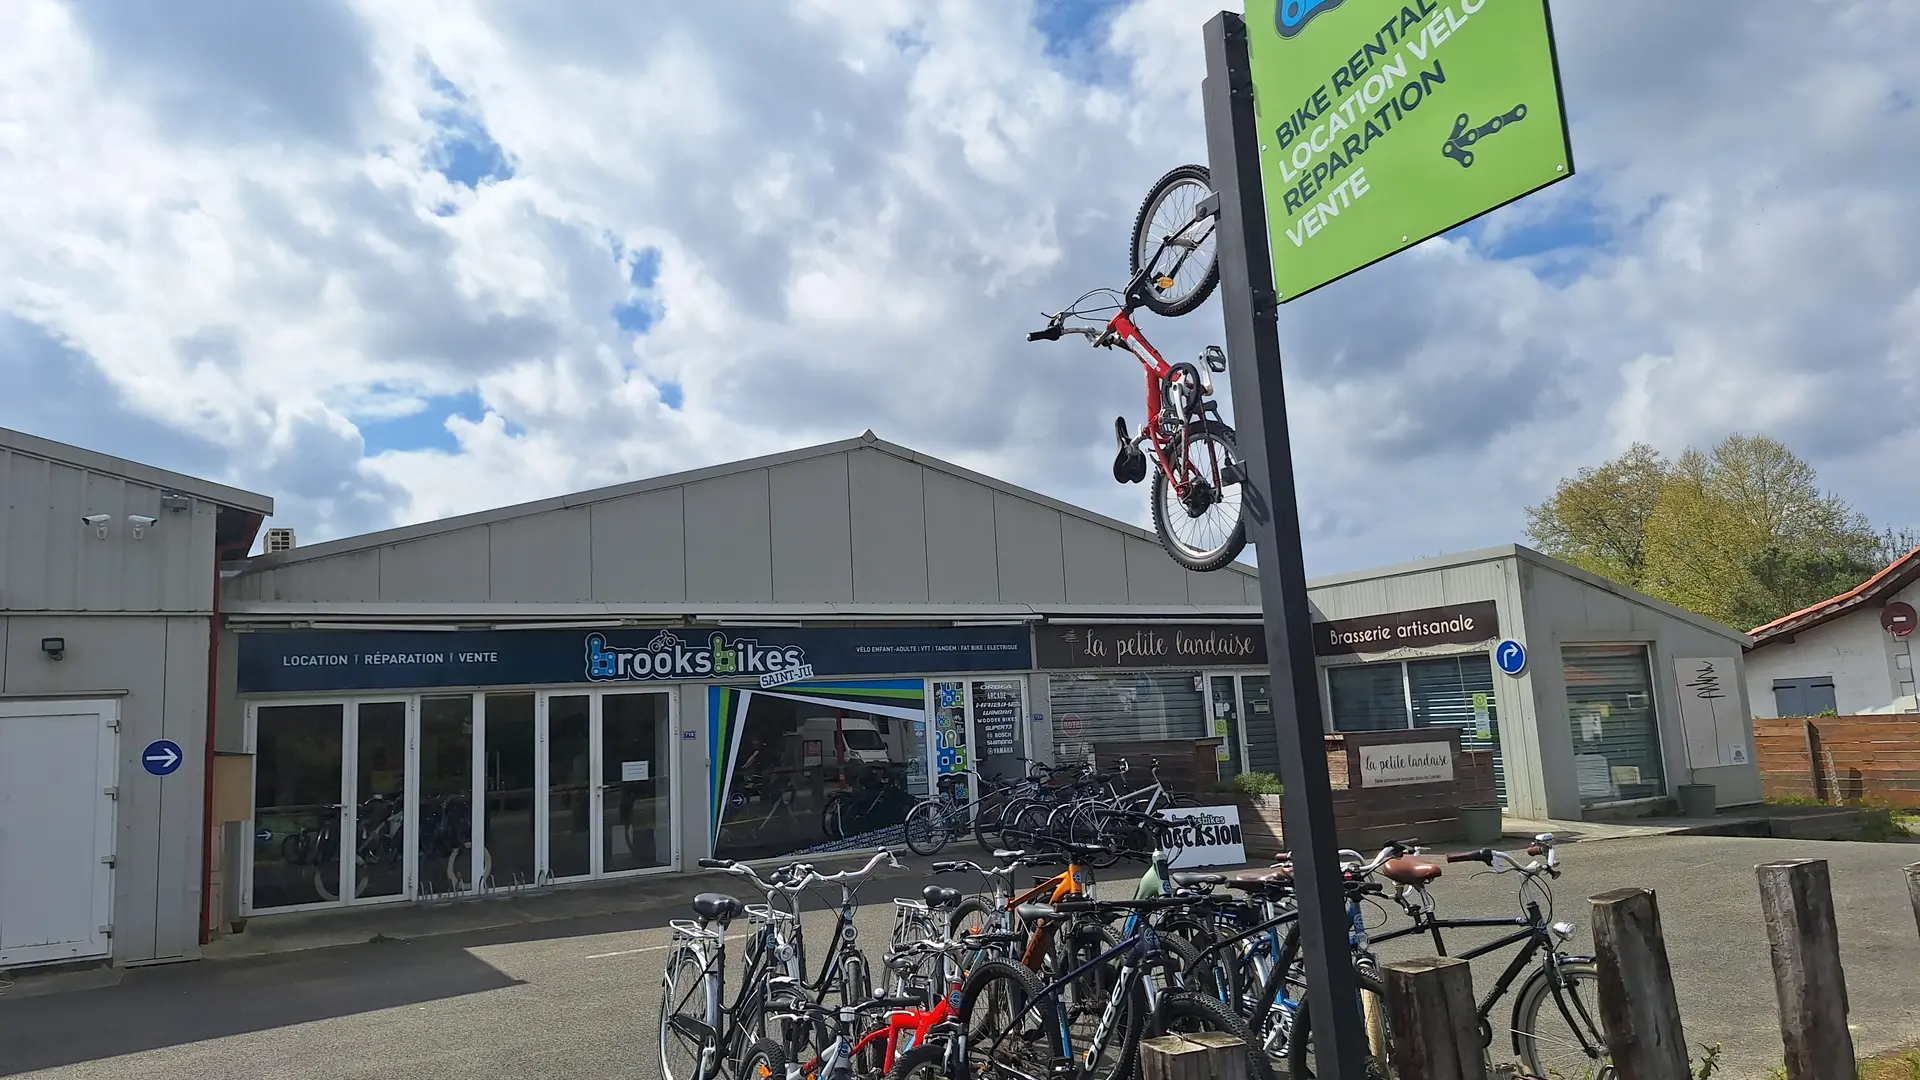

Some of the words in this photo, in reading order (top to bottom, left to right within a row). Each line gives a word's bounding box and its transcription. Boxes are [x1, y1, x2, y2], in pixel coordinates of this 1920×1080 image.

[1276, 85, 1332, 150] BIKE
[1331, 0, 1437, 97] RENTAL
[1279, 53, 1407, 183] LOCATION
[1283, 59, 1446, 216] RÉPARATION
[1285, 167, 1371, 247] VENTE
[1083, 628, 1108, 657] La
[1116, 630, 1168, 664] petite
[1176, 629, 1255, 657] landaise
[1330, 625, 1391, 645] Brasserie
[1397, 614, 1475, 638] artisanale
[283, 655, 348, 667] LOCATION
[364, 651, 444, 665] RÉPARATION
[458, 652, 498, 663] VENTE
[590, 636, 800, 677] brooksbikes
[856, 645, 871, 653] VÉLO
[872, 645, 917, 653] ENFANT-ADULTE
[761, 664, 813, 687] SAINT-JU
[1365, 755, 1378, 771] La
[1379, 755, 1406, 774] petite
[1407, 752, 1449, 768] landaise
[1162, 824, 1242, 849] OCCASION
[1085, 965, 1134, 1072] ORBEA
